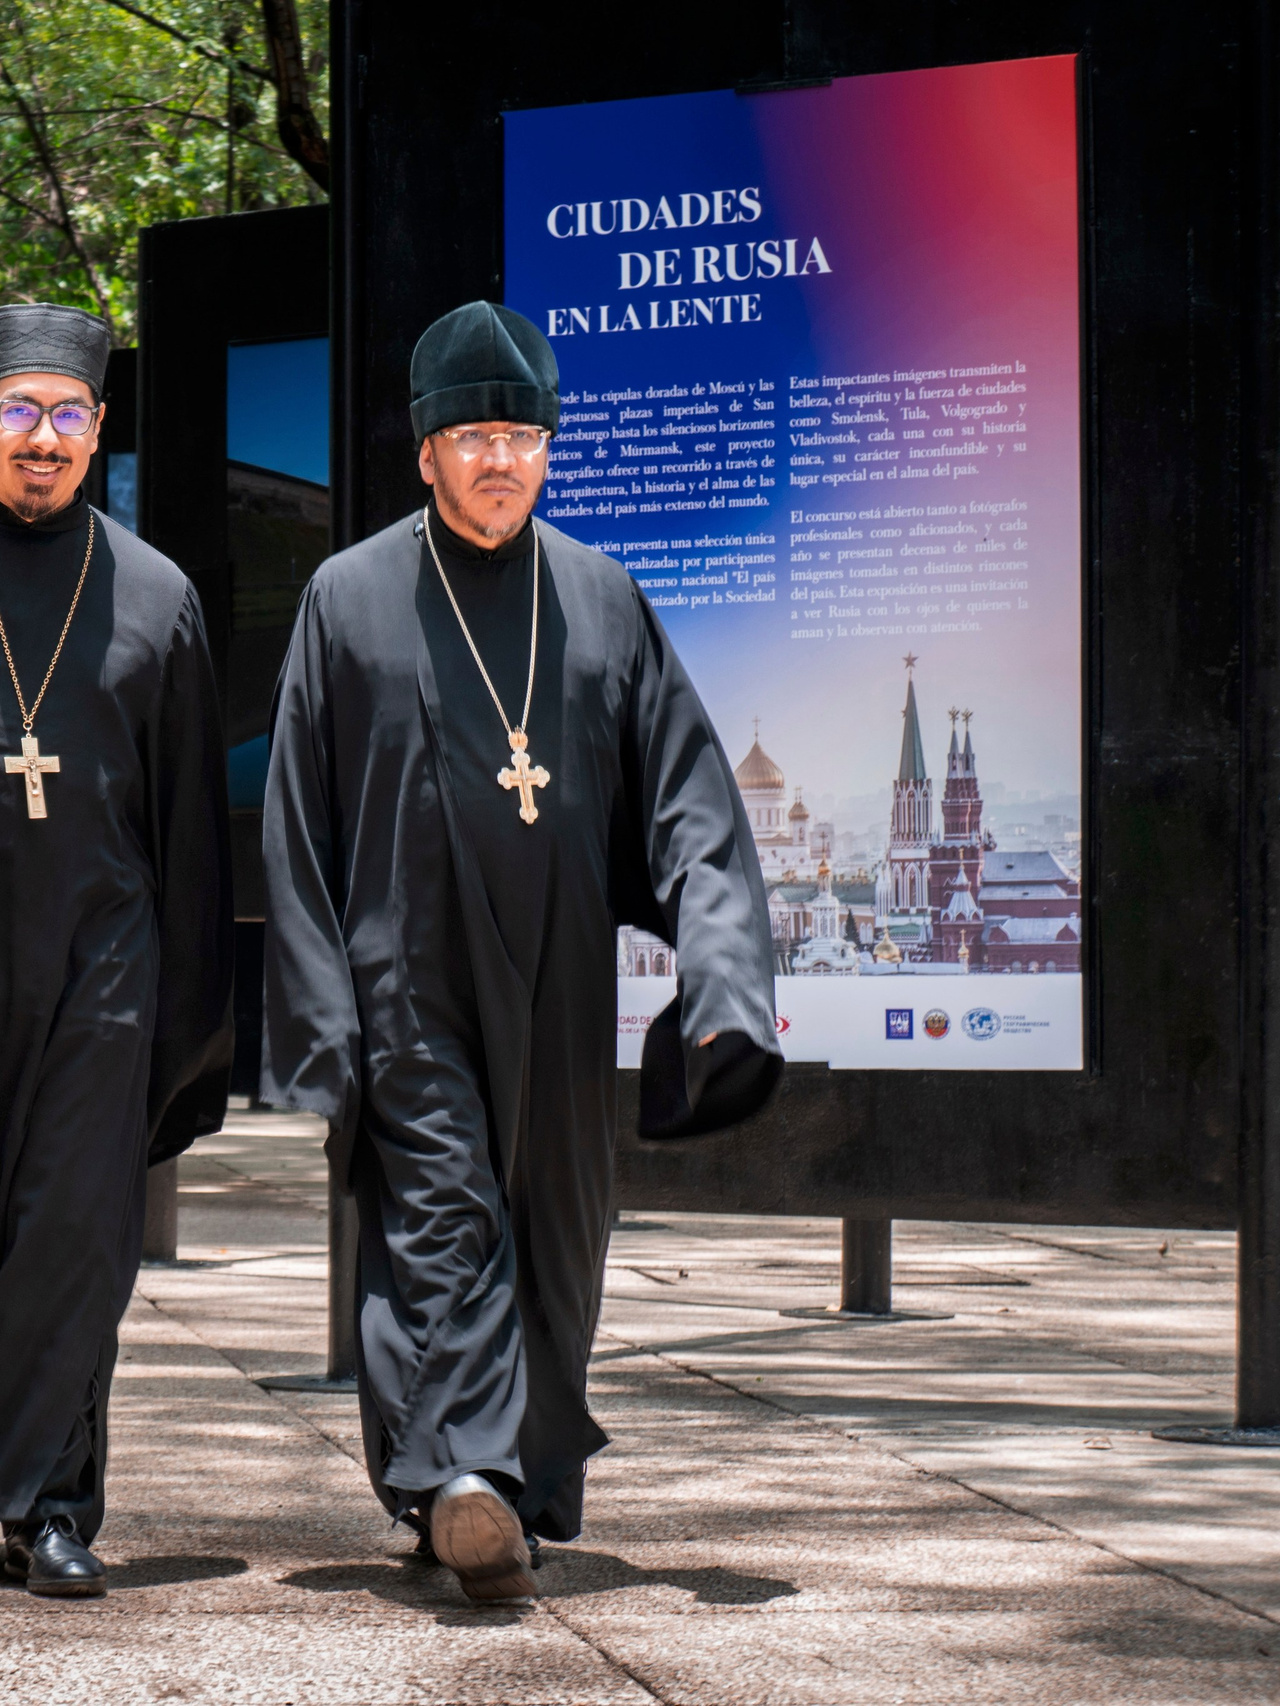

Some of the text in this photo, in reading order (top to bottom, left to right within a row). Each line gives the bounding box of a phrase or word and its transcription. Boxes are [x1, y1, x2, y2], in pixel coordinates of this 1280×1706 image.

[547, 187, 762, 239] CIUDADES
[618, 236, 832, 290] DE RUSIA
[547, 293, 762, 336] EN LA LENTE
[789, 360, 1026, 390] Estas impactantes imágenes transmiten la
[583, 390, 597, 403] las
[601, 387, 642, 405] cúpulas
[645, 384, 688, 399] doradas
[692, 382, 705, 395] de
[709, 381, 744, 394] Moscú
[748, 383, 754, 396] y
[759, 378, 774, 391] las
[789, 379, 1026, 409] belleza, el espíritu y la fuerza de ciudades
[559, 398, 774, 426] ajestuosas plazas imperiales de San
[789, 400, 1026, 427] como Smolensk, Tula, Volgogrado y
[550, 419, 775, 445] etersburgo hasta los silenciosos horizontes
[789, 420, 1026, 447] Vladivostok, cada una con su historia
[547, 438, 775, 462] árticos de Múrmansk, este proyecto
[789, 441, 1026, 467] única, su carácter inconfundible y su
[547, 454, 775, 483] fotográfico ofrece un recorrido a través de
[789, 462, 979, 488] lugar especial en el alma del país.
[547, 473, 775, 501] la arquitectura, la historia y el alma de las
[546, 493, 769, 518] ciudades del país más extenso del mundo.
[790, 498, 1027, 523] El concurso está abierto tanto a fotógrafos
[623, 539, 667, 555] presenta
[671, 539, 691, 549] una
[694, 534, 742, 547] selección
[745, 532, 775, 545] única
[790, 517, 1027, 547] profesionales como aficionados, y cada
[624, 552, 775, 571] realizadas por participantes
[790, 537, 1028, 564] año se presentan decenas de miles de
[682, 571, 727, 586] nacional
[753, 570, 776, 587] país
[790, 559, 1028, 584] imágenes tomadas en distintos rincones
[691, 595, 709, 609] por
[713, 590, 722, 604] la
[726, 588, 775, 603] Sociedad
[790, 578, 1028, 603] del país. Esta exposición es una invitación
[790, 596, 1028, 620] a ver Rusia con los ojos de quienes la
[790, 619, 982, 641] aman y la observan con atención.
